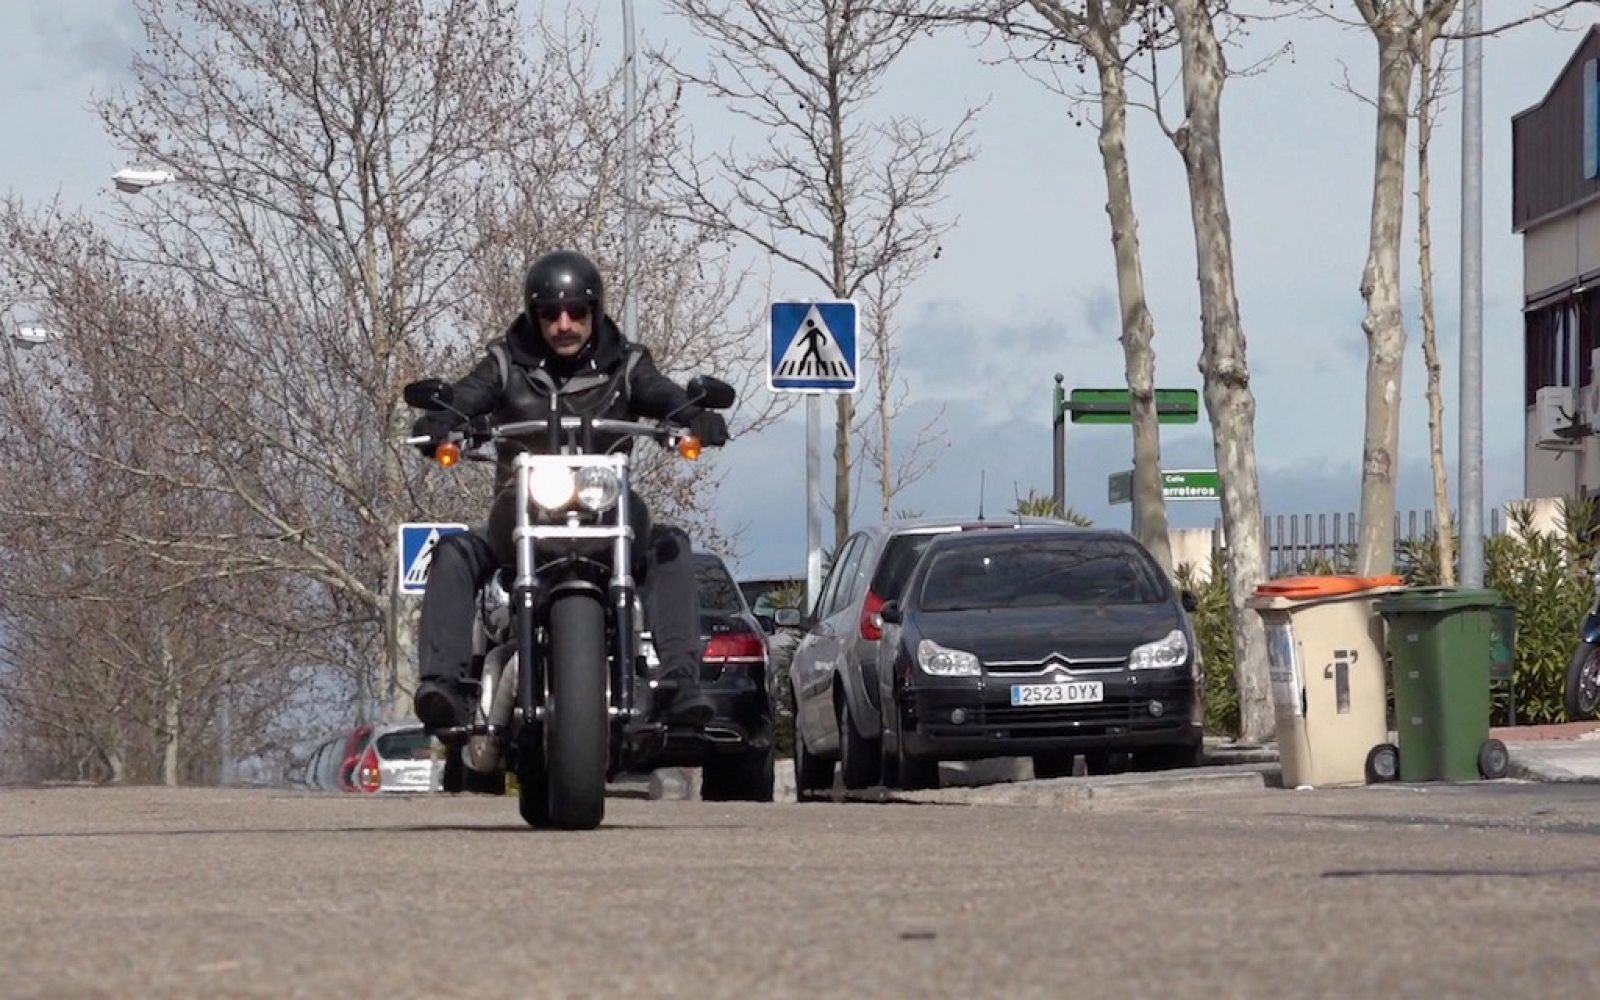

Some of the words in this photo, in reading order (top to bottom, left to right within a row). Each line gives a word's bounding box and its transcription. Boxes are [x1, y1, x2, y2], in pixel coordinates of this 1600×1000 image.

[1165, 475, 1185, 483] Calle
[1163, 486, 1215, 496] arreteros
[1023, 686, 1063, 702] 2523
[1068, 684, 1098, 699] DYX
